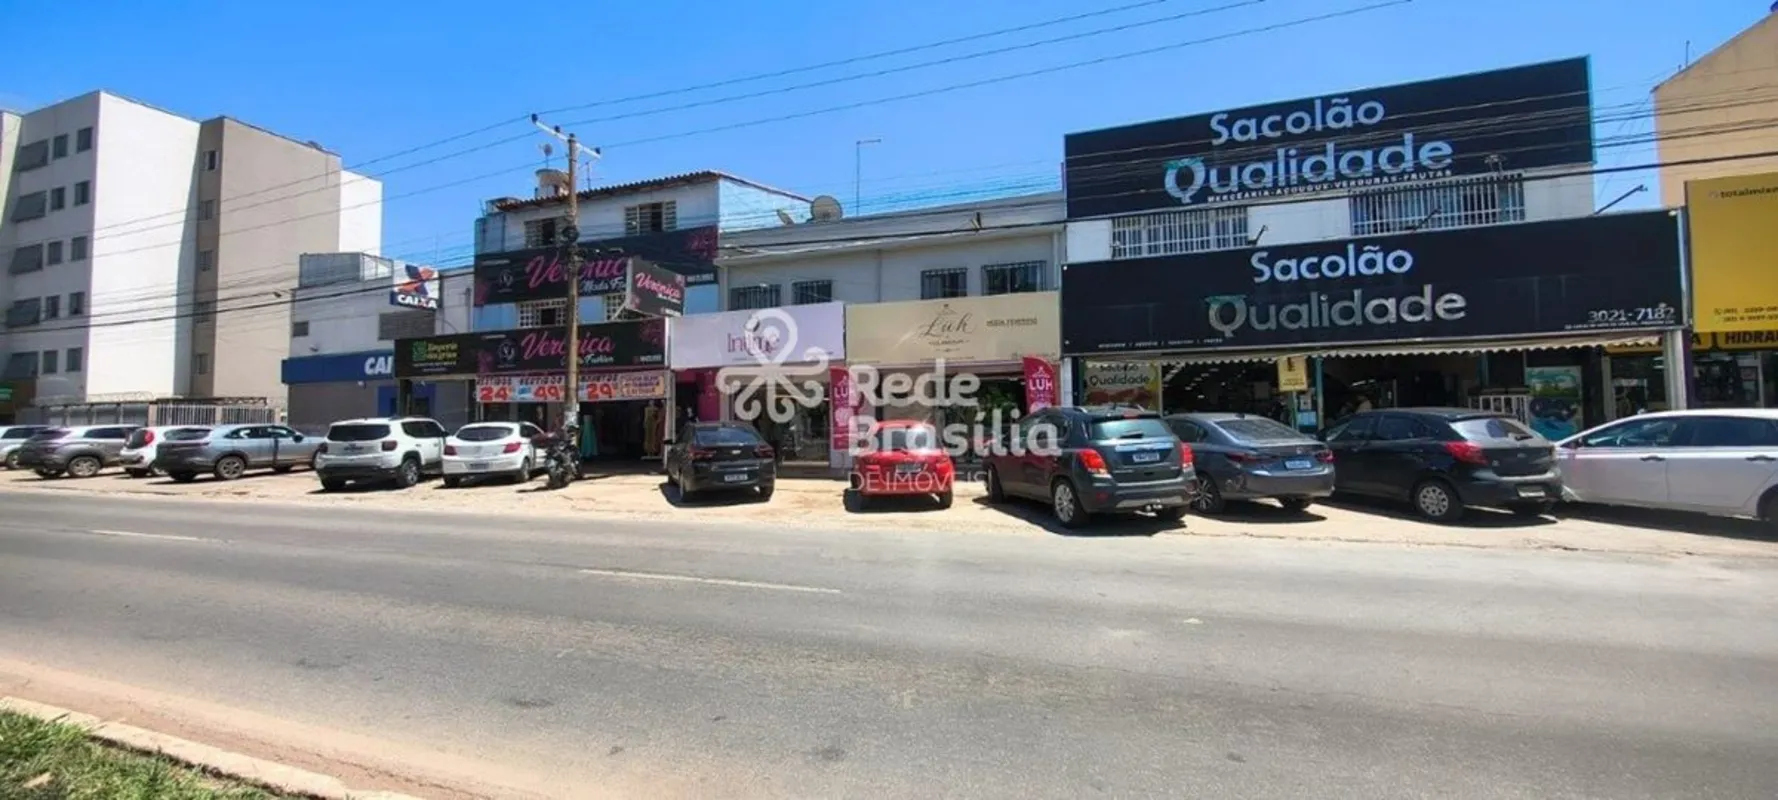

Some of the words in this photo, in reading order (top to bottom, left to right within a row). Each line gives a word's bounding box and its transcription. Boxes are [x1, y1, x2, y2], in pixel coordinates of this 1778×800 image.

[1210, 97, 1384, 145] Sacolão
[1164, 133, 1453, 204] Qualidade
[1250, 243, 1413, 284] Sacolão
[397, 294, 437, 309] CAIXA
[1205, 284, 1467, 336] Qualidade
[1725, 331, 1778, 345] HIDRA
[1029, 379, 1053, 390] LUH
